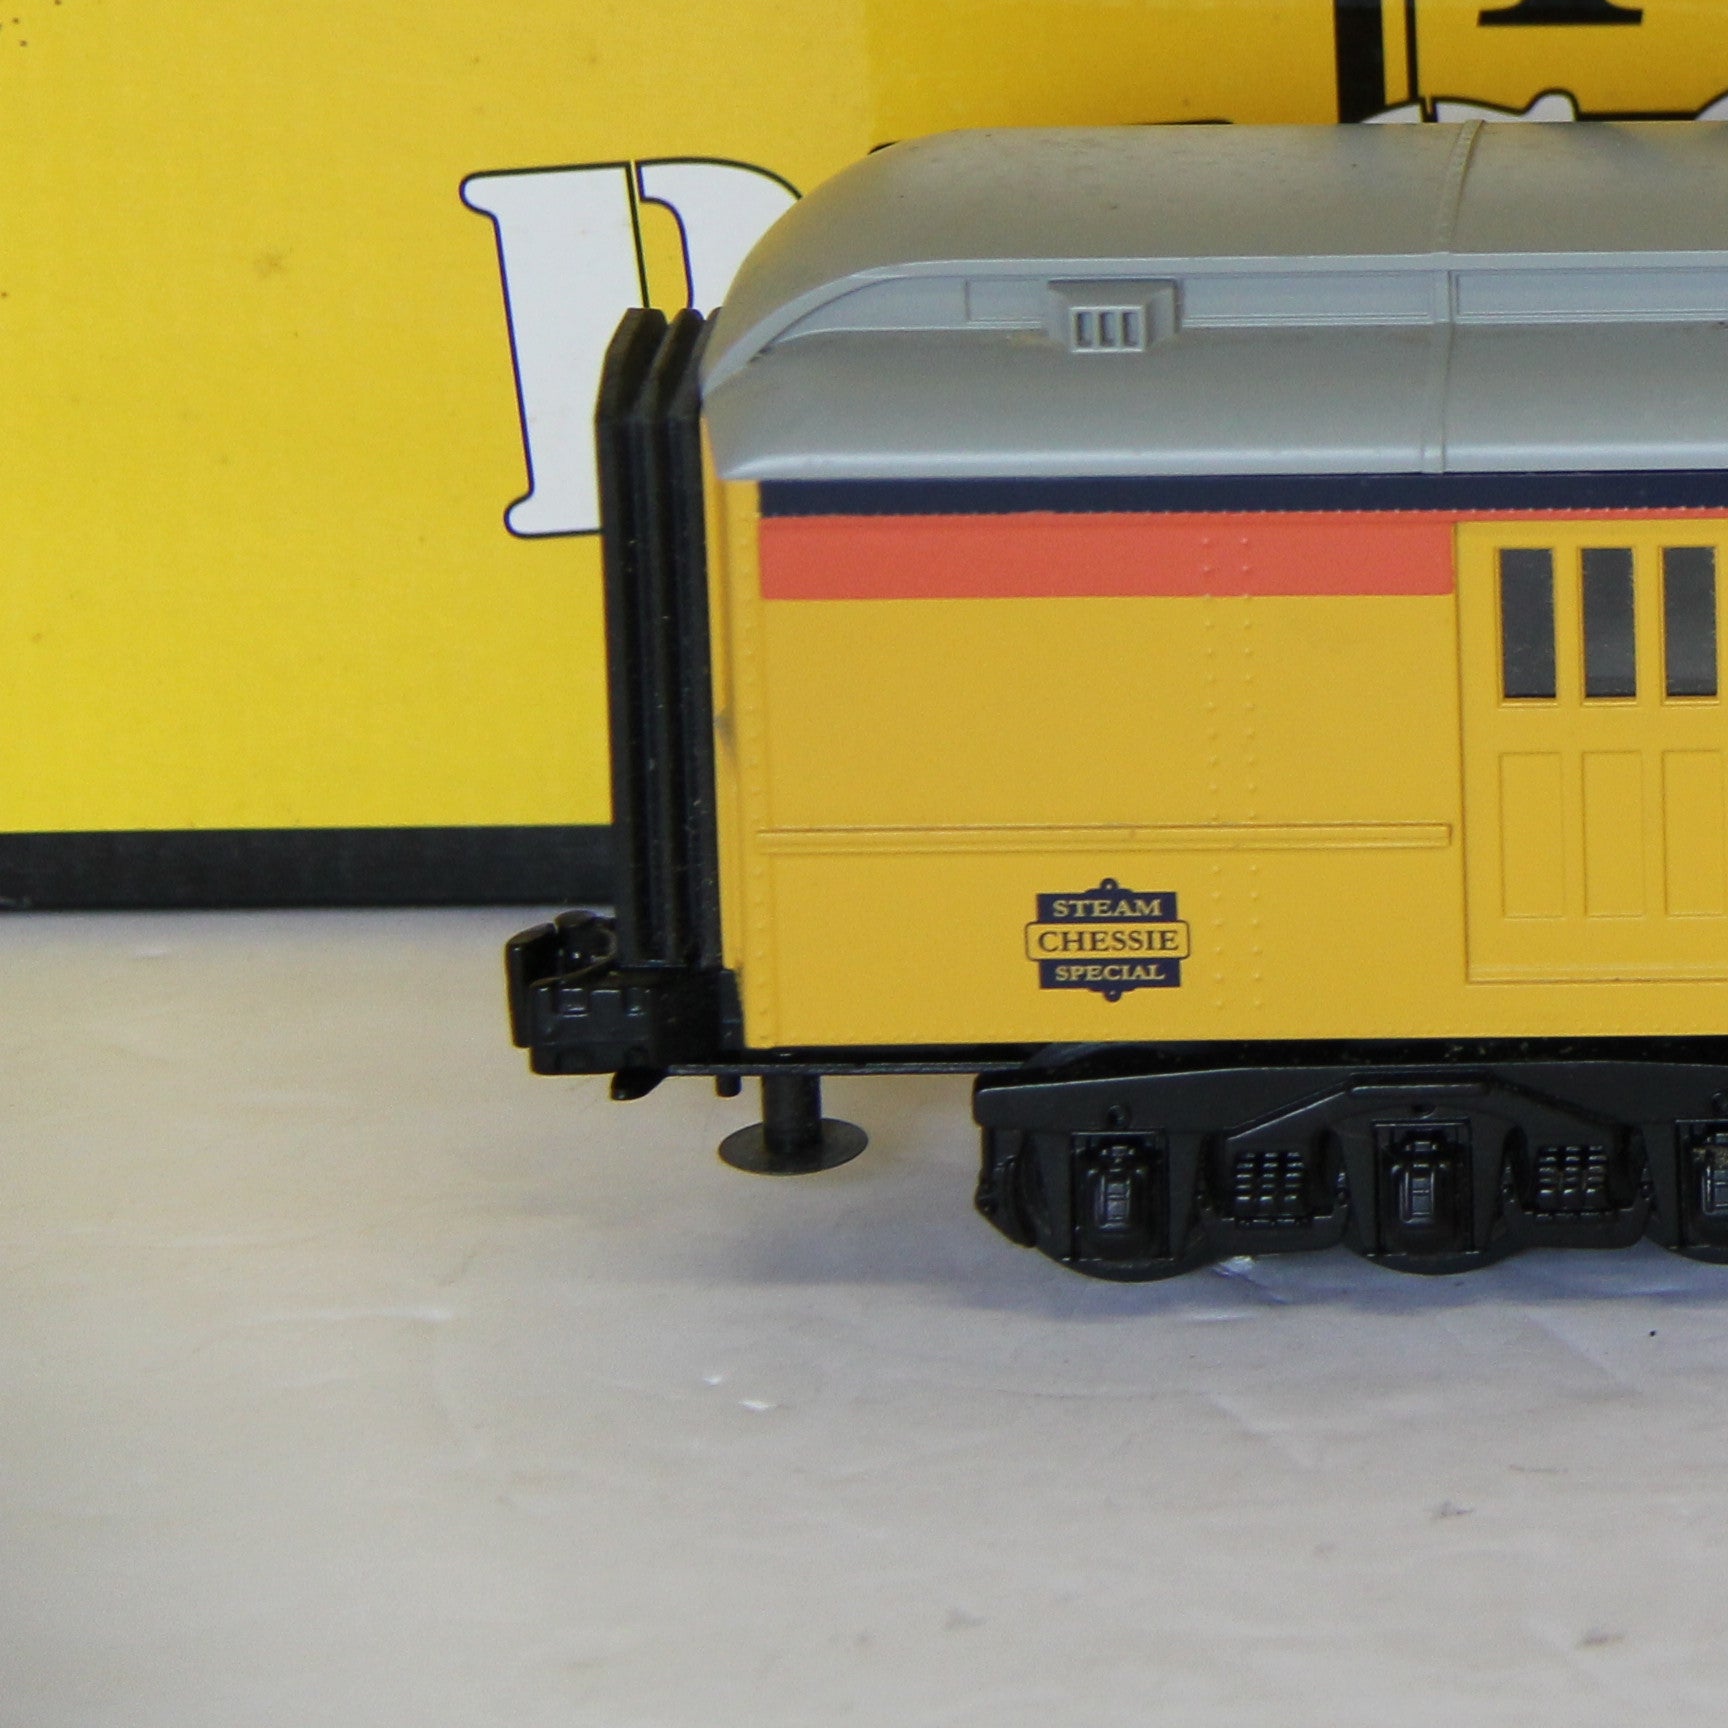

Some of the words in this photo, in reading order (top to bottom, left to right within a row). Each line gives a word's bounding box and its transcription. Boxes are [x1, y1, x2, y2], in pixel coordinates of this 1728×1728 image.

[1052, 899, 1163, 917] STEAM
[1037, 930, 1180, 952] CHESSIE
[1055, 964, 1167, 981] SPECIAL
